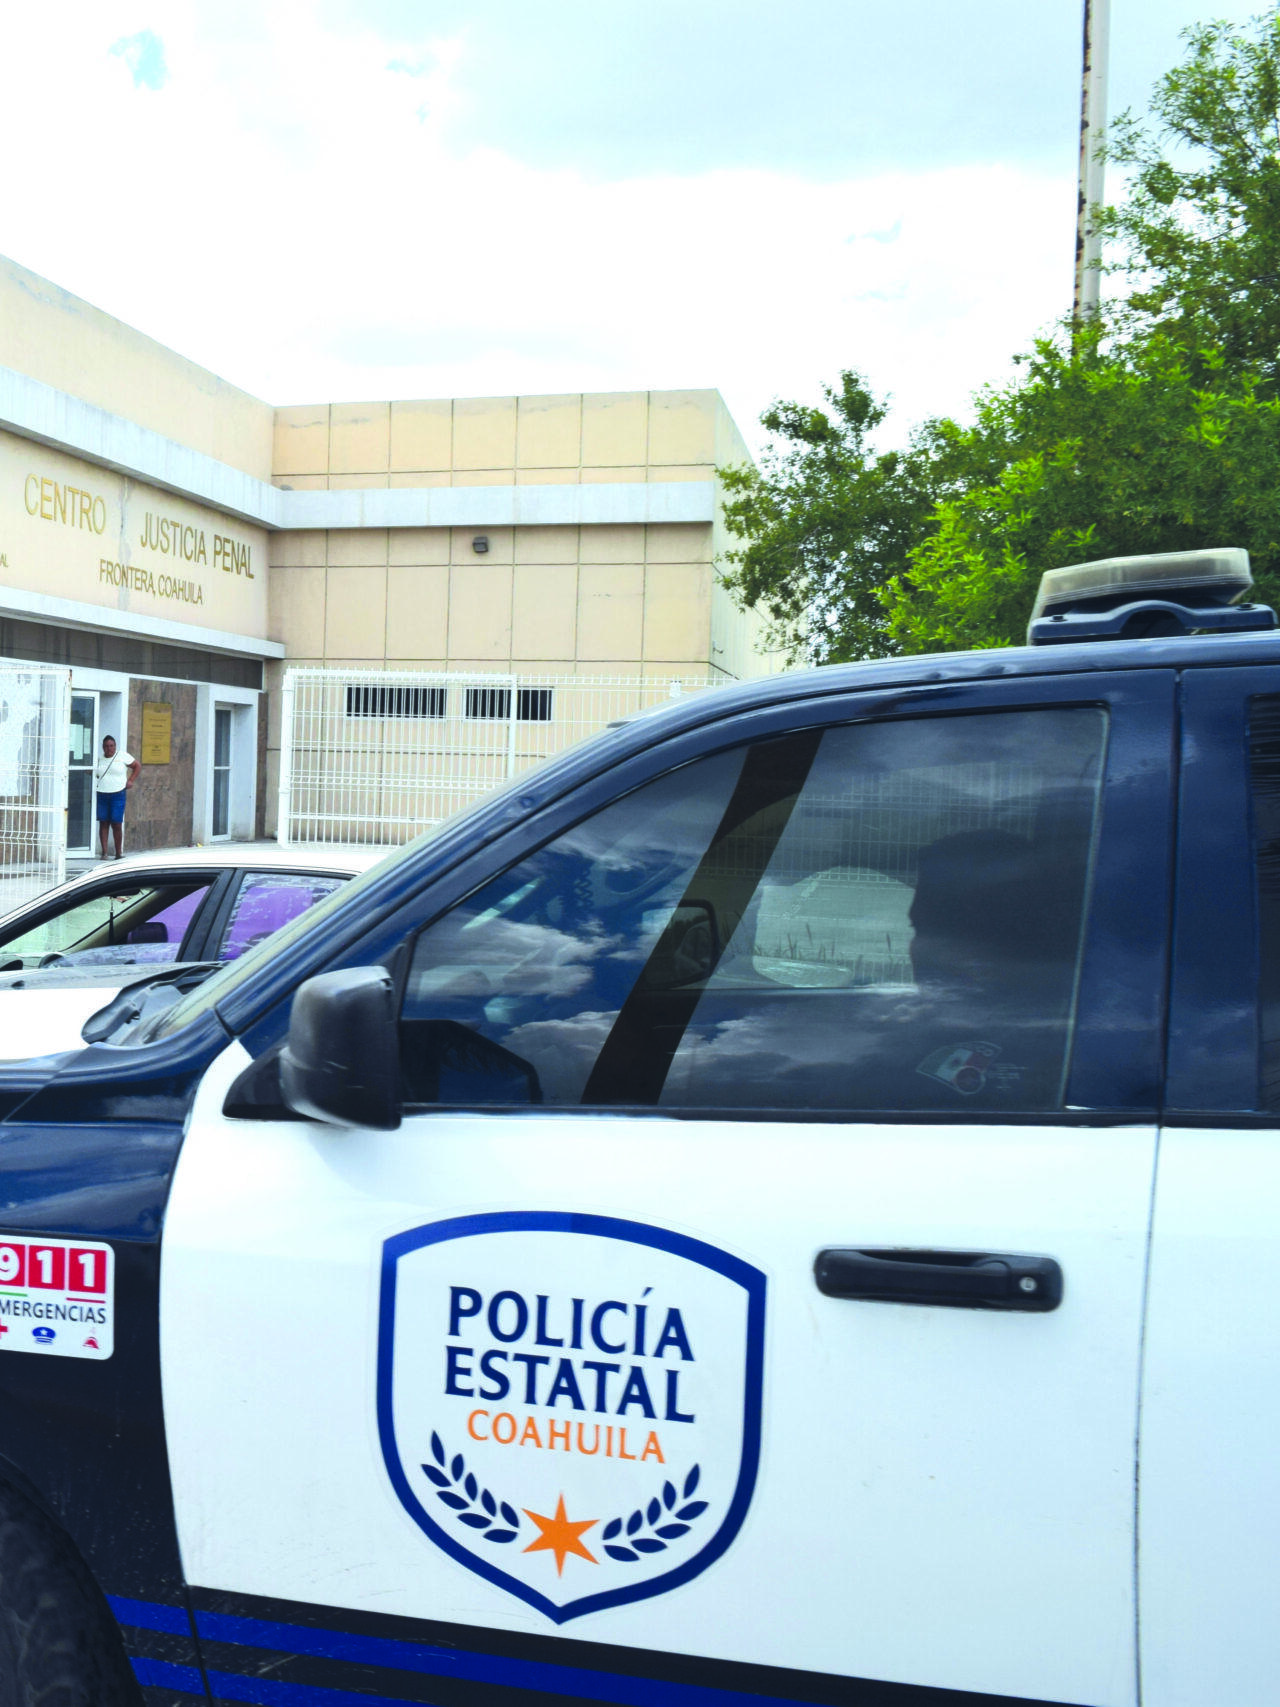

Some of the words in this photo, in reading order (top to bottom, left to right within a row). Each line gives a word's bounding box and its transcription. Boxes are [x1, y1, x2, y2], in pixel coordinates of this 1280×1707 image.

[24, 473, 106, 535] CENTRO
[140, 511, 207, 566] JUSTICIA
[214, 533, 254, 579] PENAL
[158, 574, 203, 605] COAHUILA
[447, 1286, 695, 1362] POLICÍA
[444, 1345, 695, 1424] ESTATAL
[467, 1409, 666, 1465] COAHUILA
